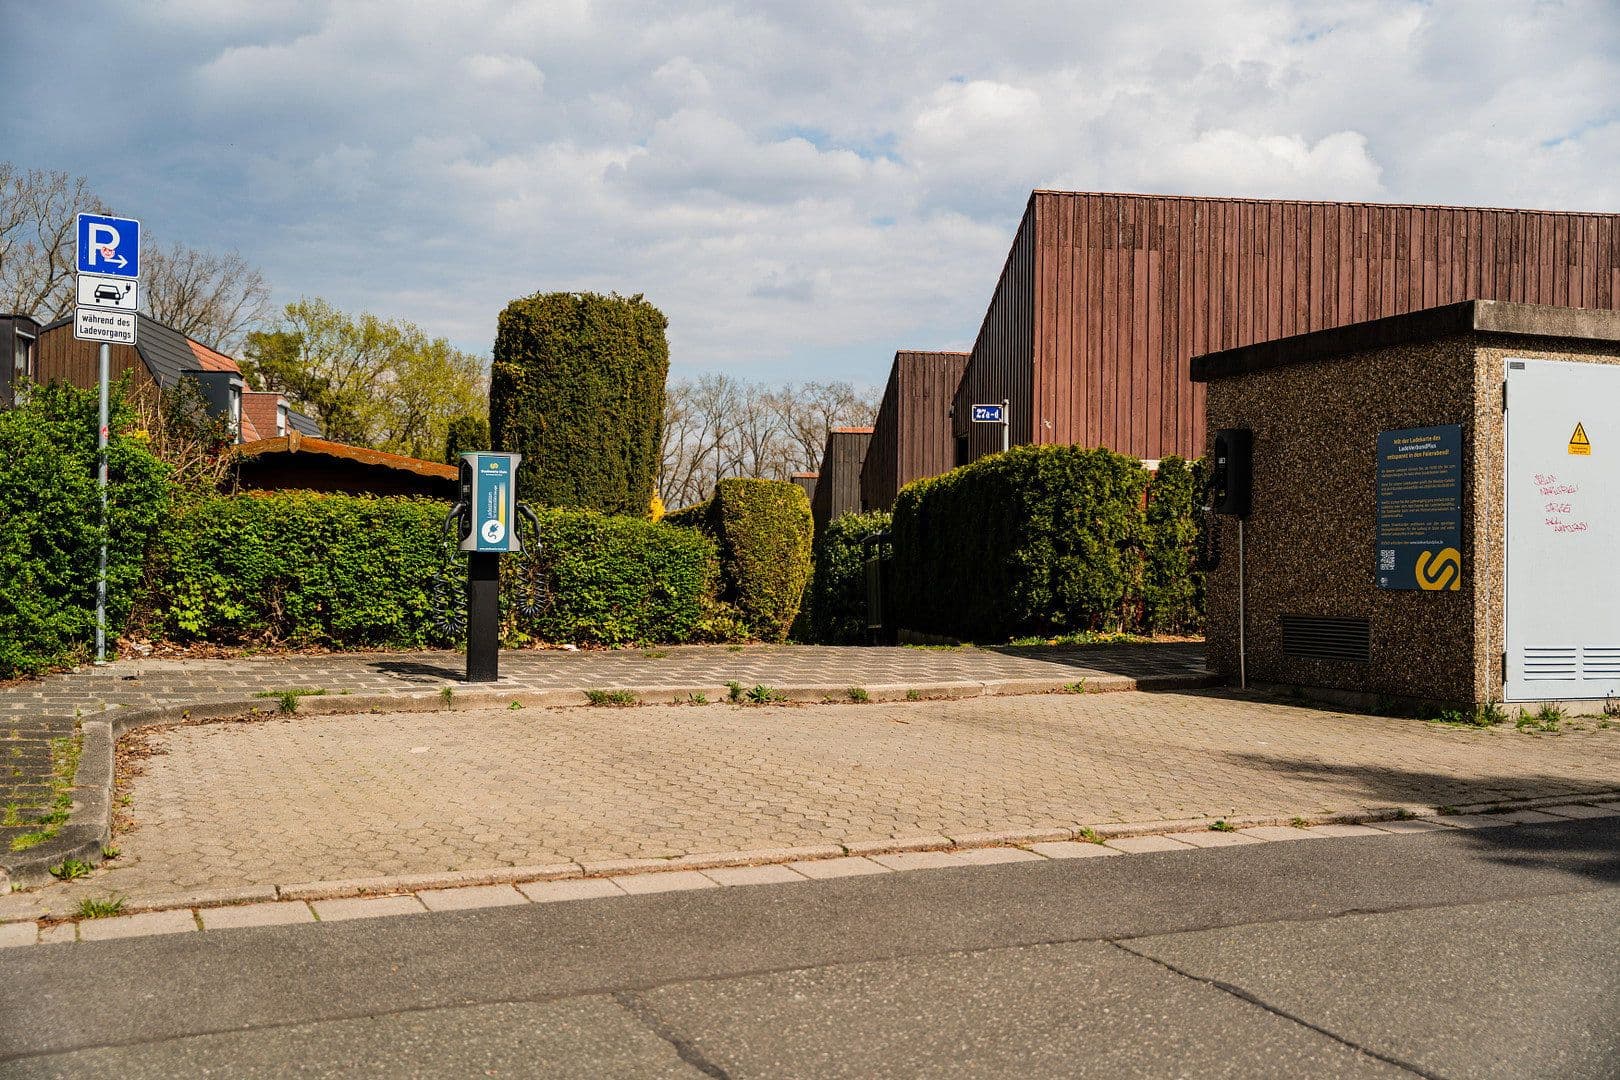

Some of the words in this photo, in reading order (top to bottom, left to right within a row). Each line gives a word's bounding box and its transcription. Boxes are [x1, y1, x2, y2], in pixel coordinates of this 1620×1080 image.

[88, 222, 120, 266] P
[82, 314, 114, 325] während
[117, 317, 131, 327] des
[80, 325, 131, 340] Ladevorgangs
[976, 408, 999, 419] 27a-d
